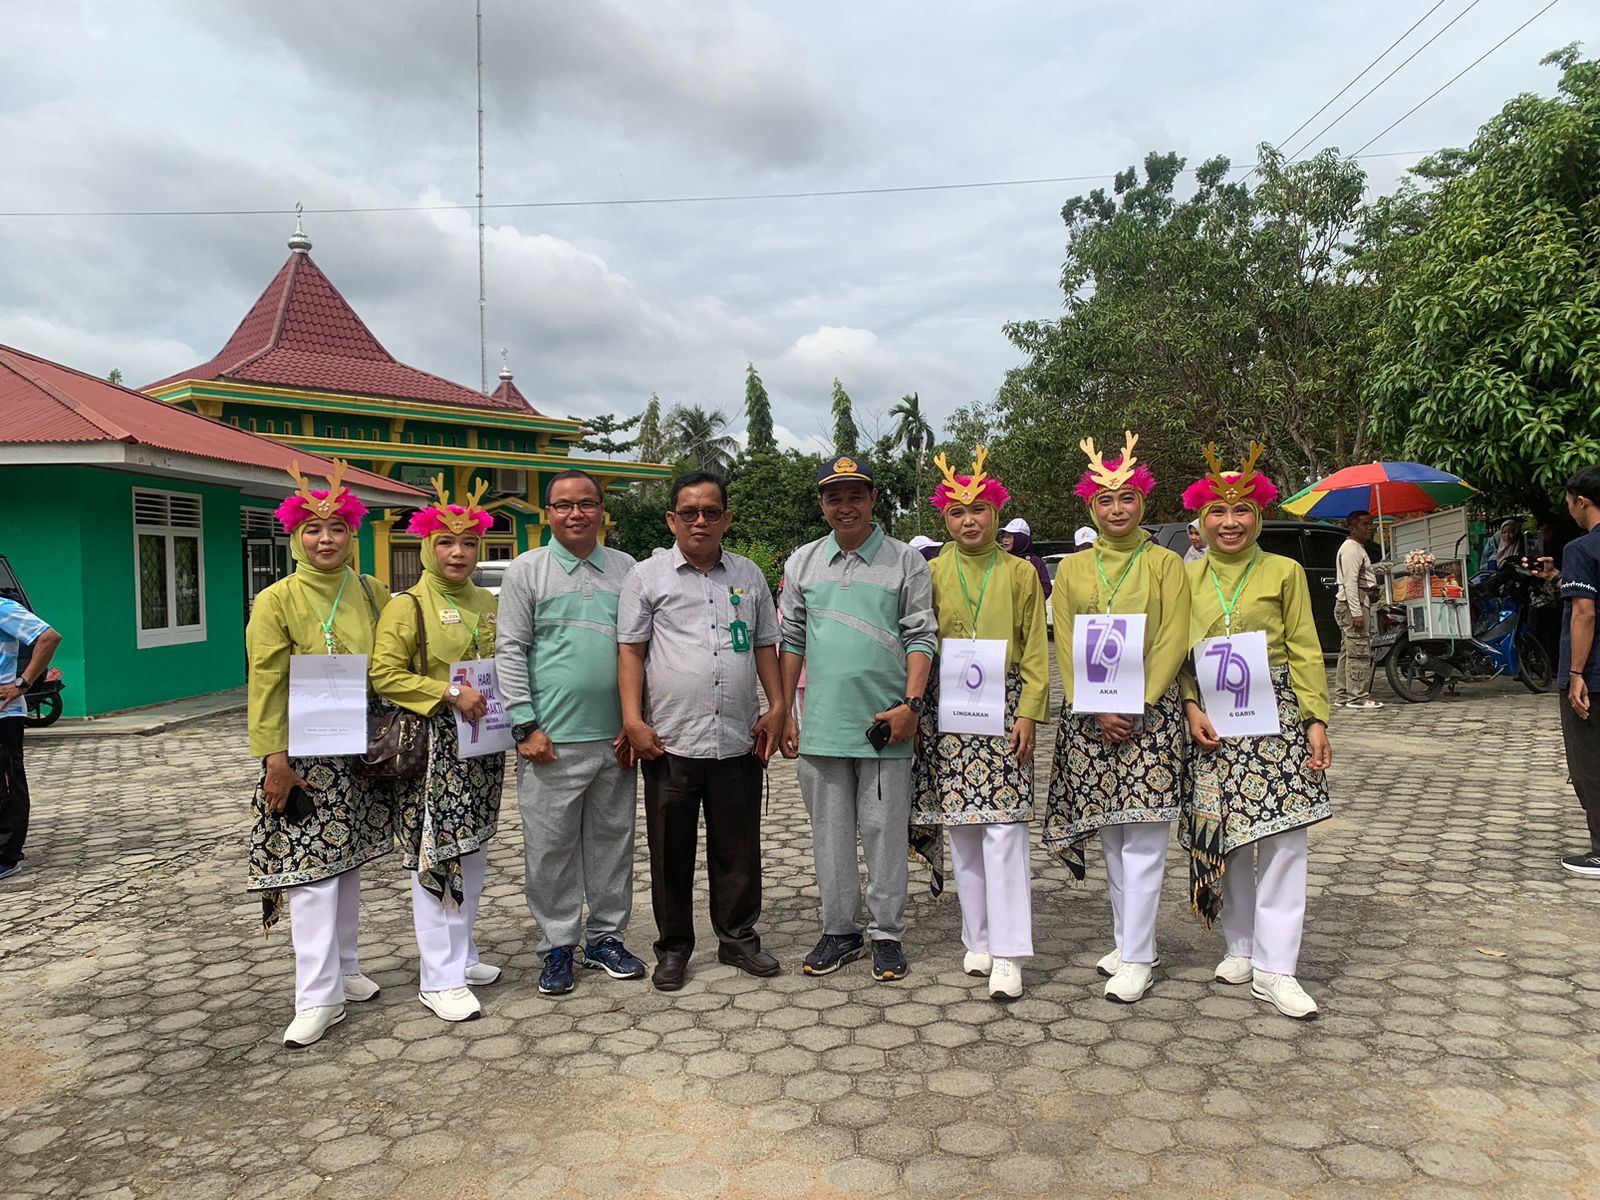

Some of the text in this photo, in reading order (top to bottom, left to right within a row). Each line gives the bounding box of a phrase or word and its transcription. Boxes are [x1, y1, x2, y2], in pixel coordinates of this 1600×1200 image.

[477, 673, 491, 686] HARI
[1205, 643, 1250, 708] 79
[484, 702, 504, 715] HAKTI
[952, 710, 989, 718] LINGKARAN
